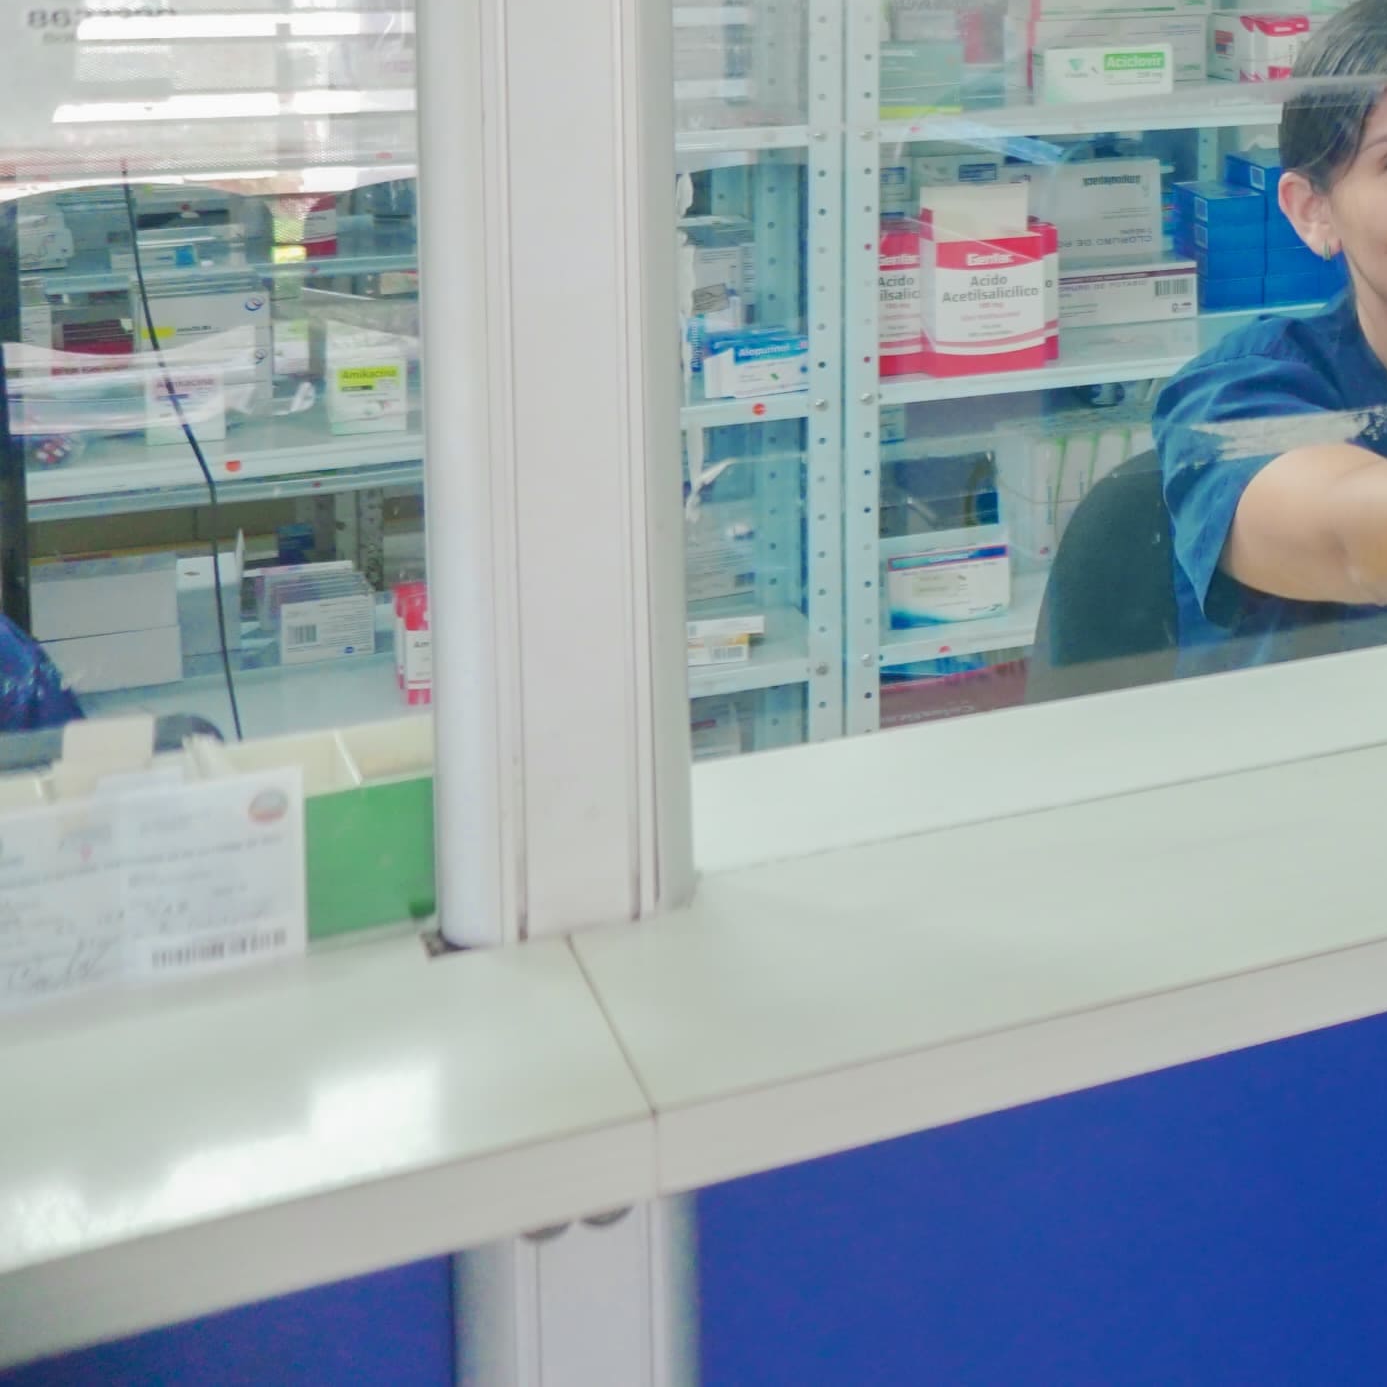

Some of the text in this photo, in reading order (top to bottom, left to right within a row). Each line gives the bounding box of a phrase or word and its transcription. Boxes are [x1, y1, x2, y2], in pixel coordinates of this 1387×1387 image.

[1106, 53, 1163, 69] Aciclovir
[970, 273, 1008, 287] Acido
[340, 367, 398, 381] Amikacina
